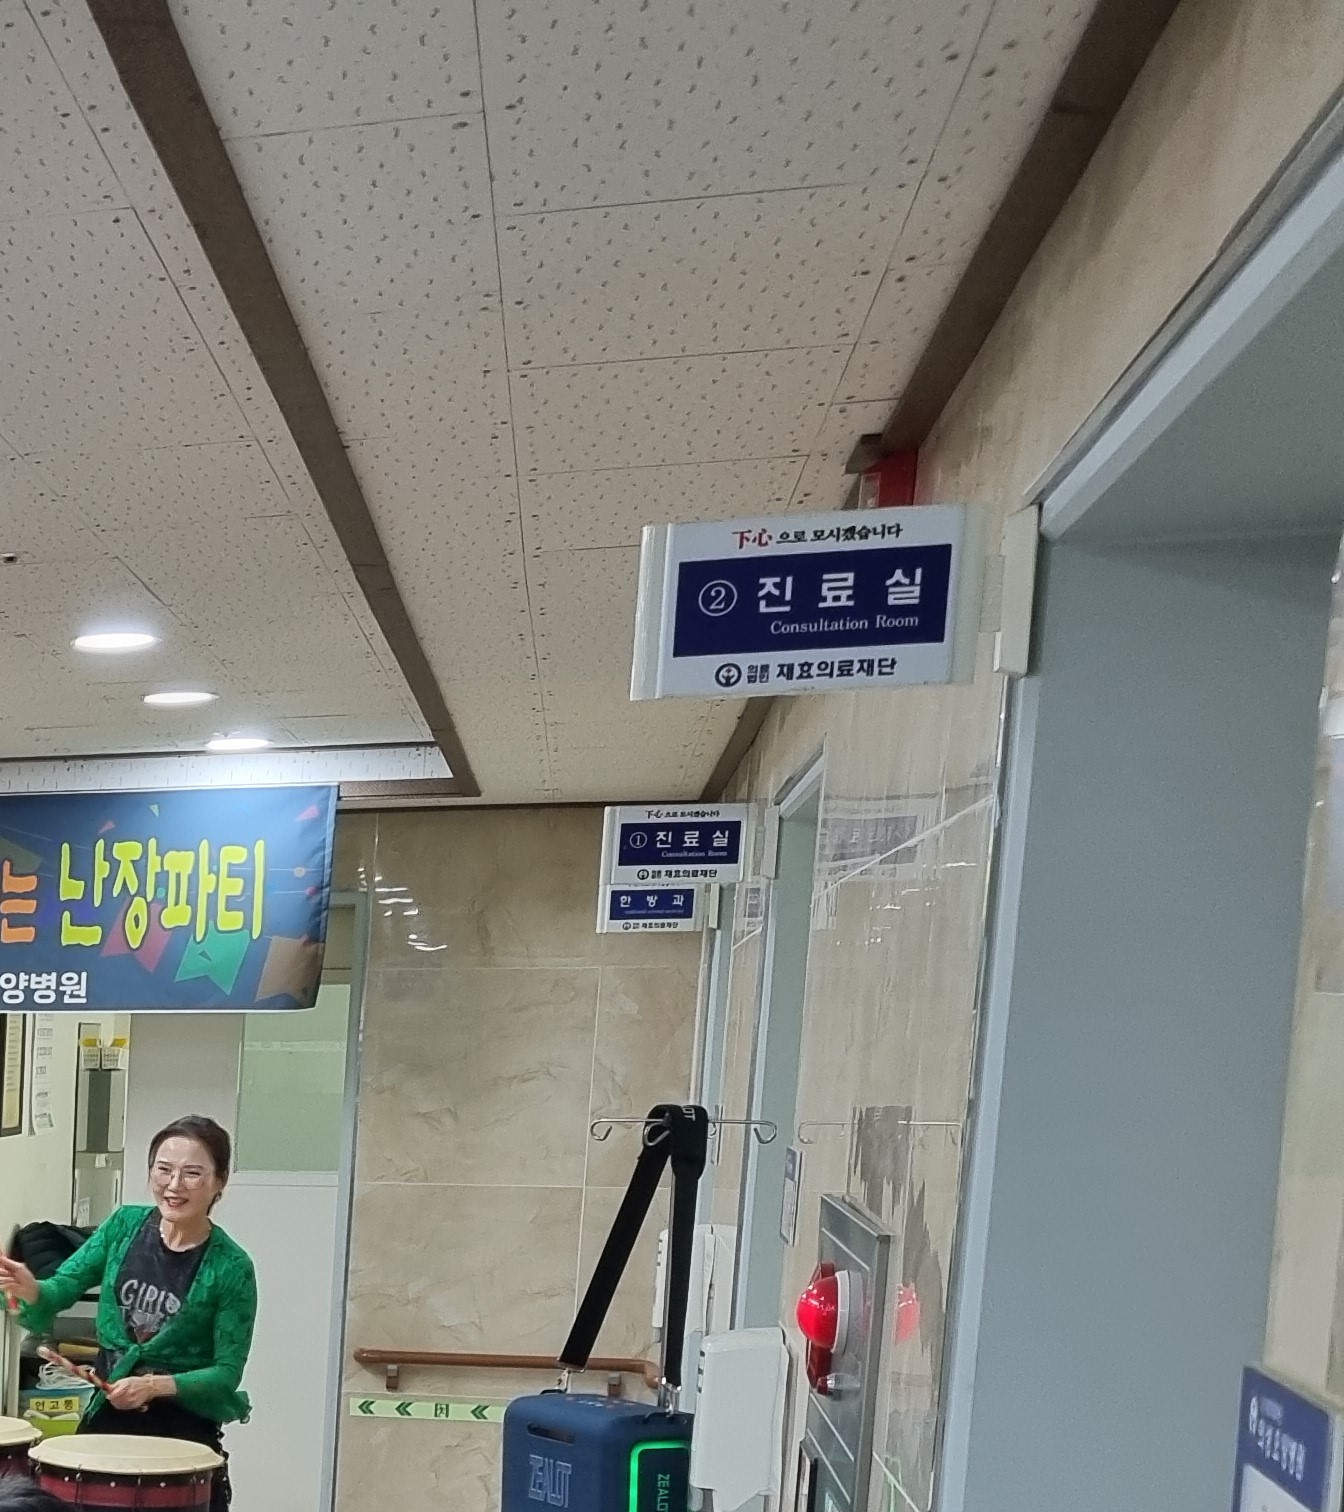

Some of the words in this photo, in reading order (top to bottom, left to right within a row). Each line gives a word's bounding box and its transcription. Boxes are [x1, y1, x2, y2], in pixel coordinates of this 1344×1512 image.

[776, 531, 808, 544] 으로
[810, 523, 904, 543] 모시겠습니다
[770, 617, 869, 635] Consultation
[875, 613, 920, 629] Room
[776, 657, 898, 681] 재효의료재단
[58, 838, 265, 947] 난장파티
